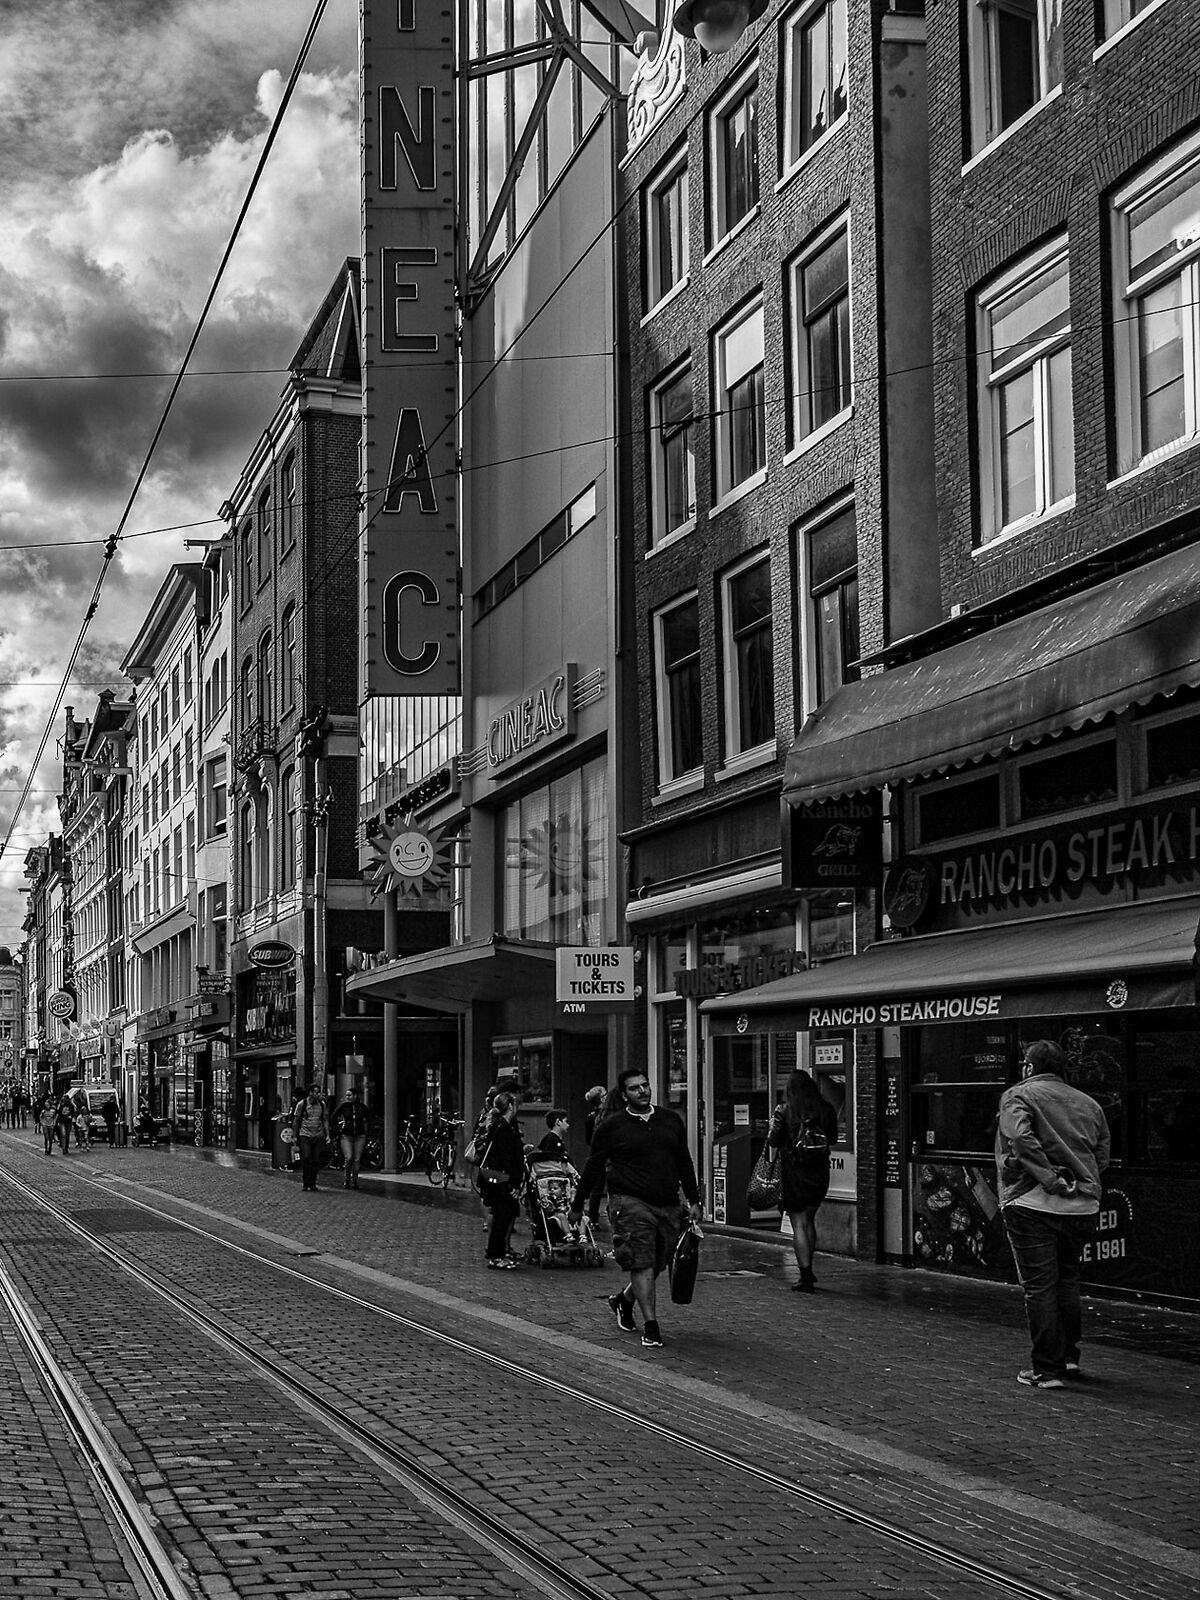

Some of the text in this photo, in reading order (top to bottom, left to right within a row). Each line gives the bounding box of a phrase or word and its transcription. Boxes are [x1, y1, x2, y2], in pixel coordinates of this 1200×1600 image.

[380, 0, 441, 676] NEAC
[486, 675, 564, 768] CINEAC
[800, 799, 875, 820] Rancho
[941, 838, 1058, 904] RANCHO
[1067, 812, 1176, 882] STEAK
[817, 863, 862, 877] GRILL
[251, 949, 293, 960] SUBWAY
[574, 953, 620, 967] TOURS
[591, 967, 602, 980] &
[673, 964, 721, 998] TOURS
[738, 950, 807, 990] TICKETS
[569, 980, 625, 994] TICKETS
[51, 1000, 71, 1011] KING
[563, 1004, 586, 1013] ATM
[808, 995, 1002, 1028] RANCHO STEAKHOUSE
[829, 1157, 844, 1170] TM
[1095, 1209, 1118, 1231] ED
[1096, 1237, 1126, 1261] 1981
